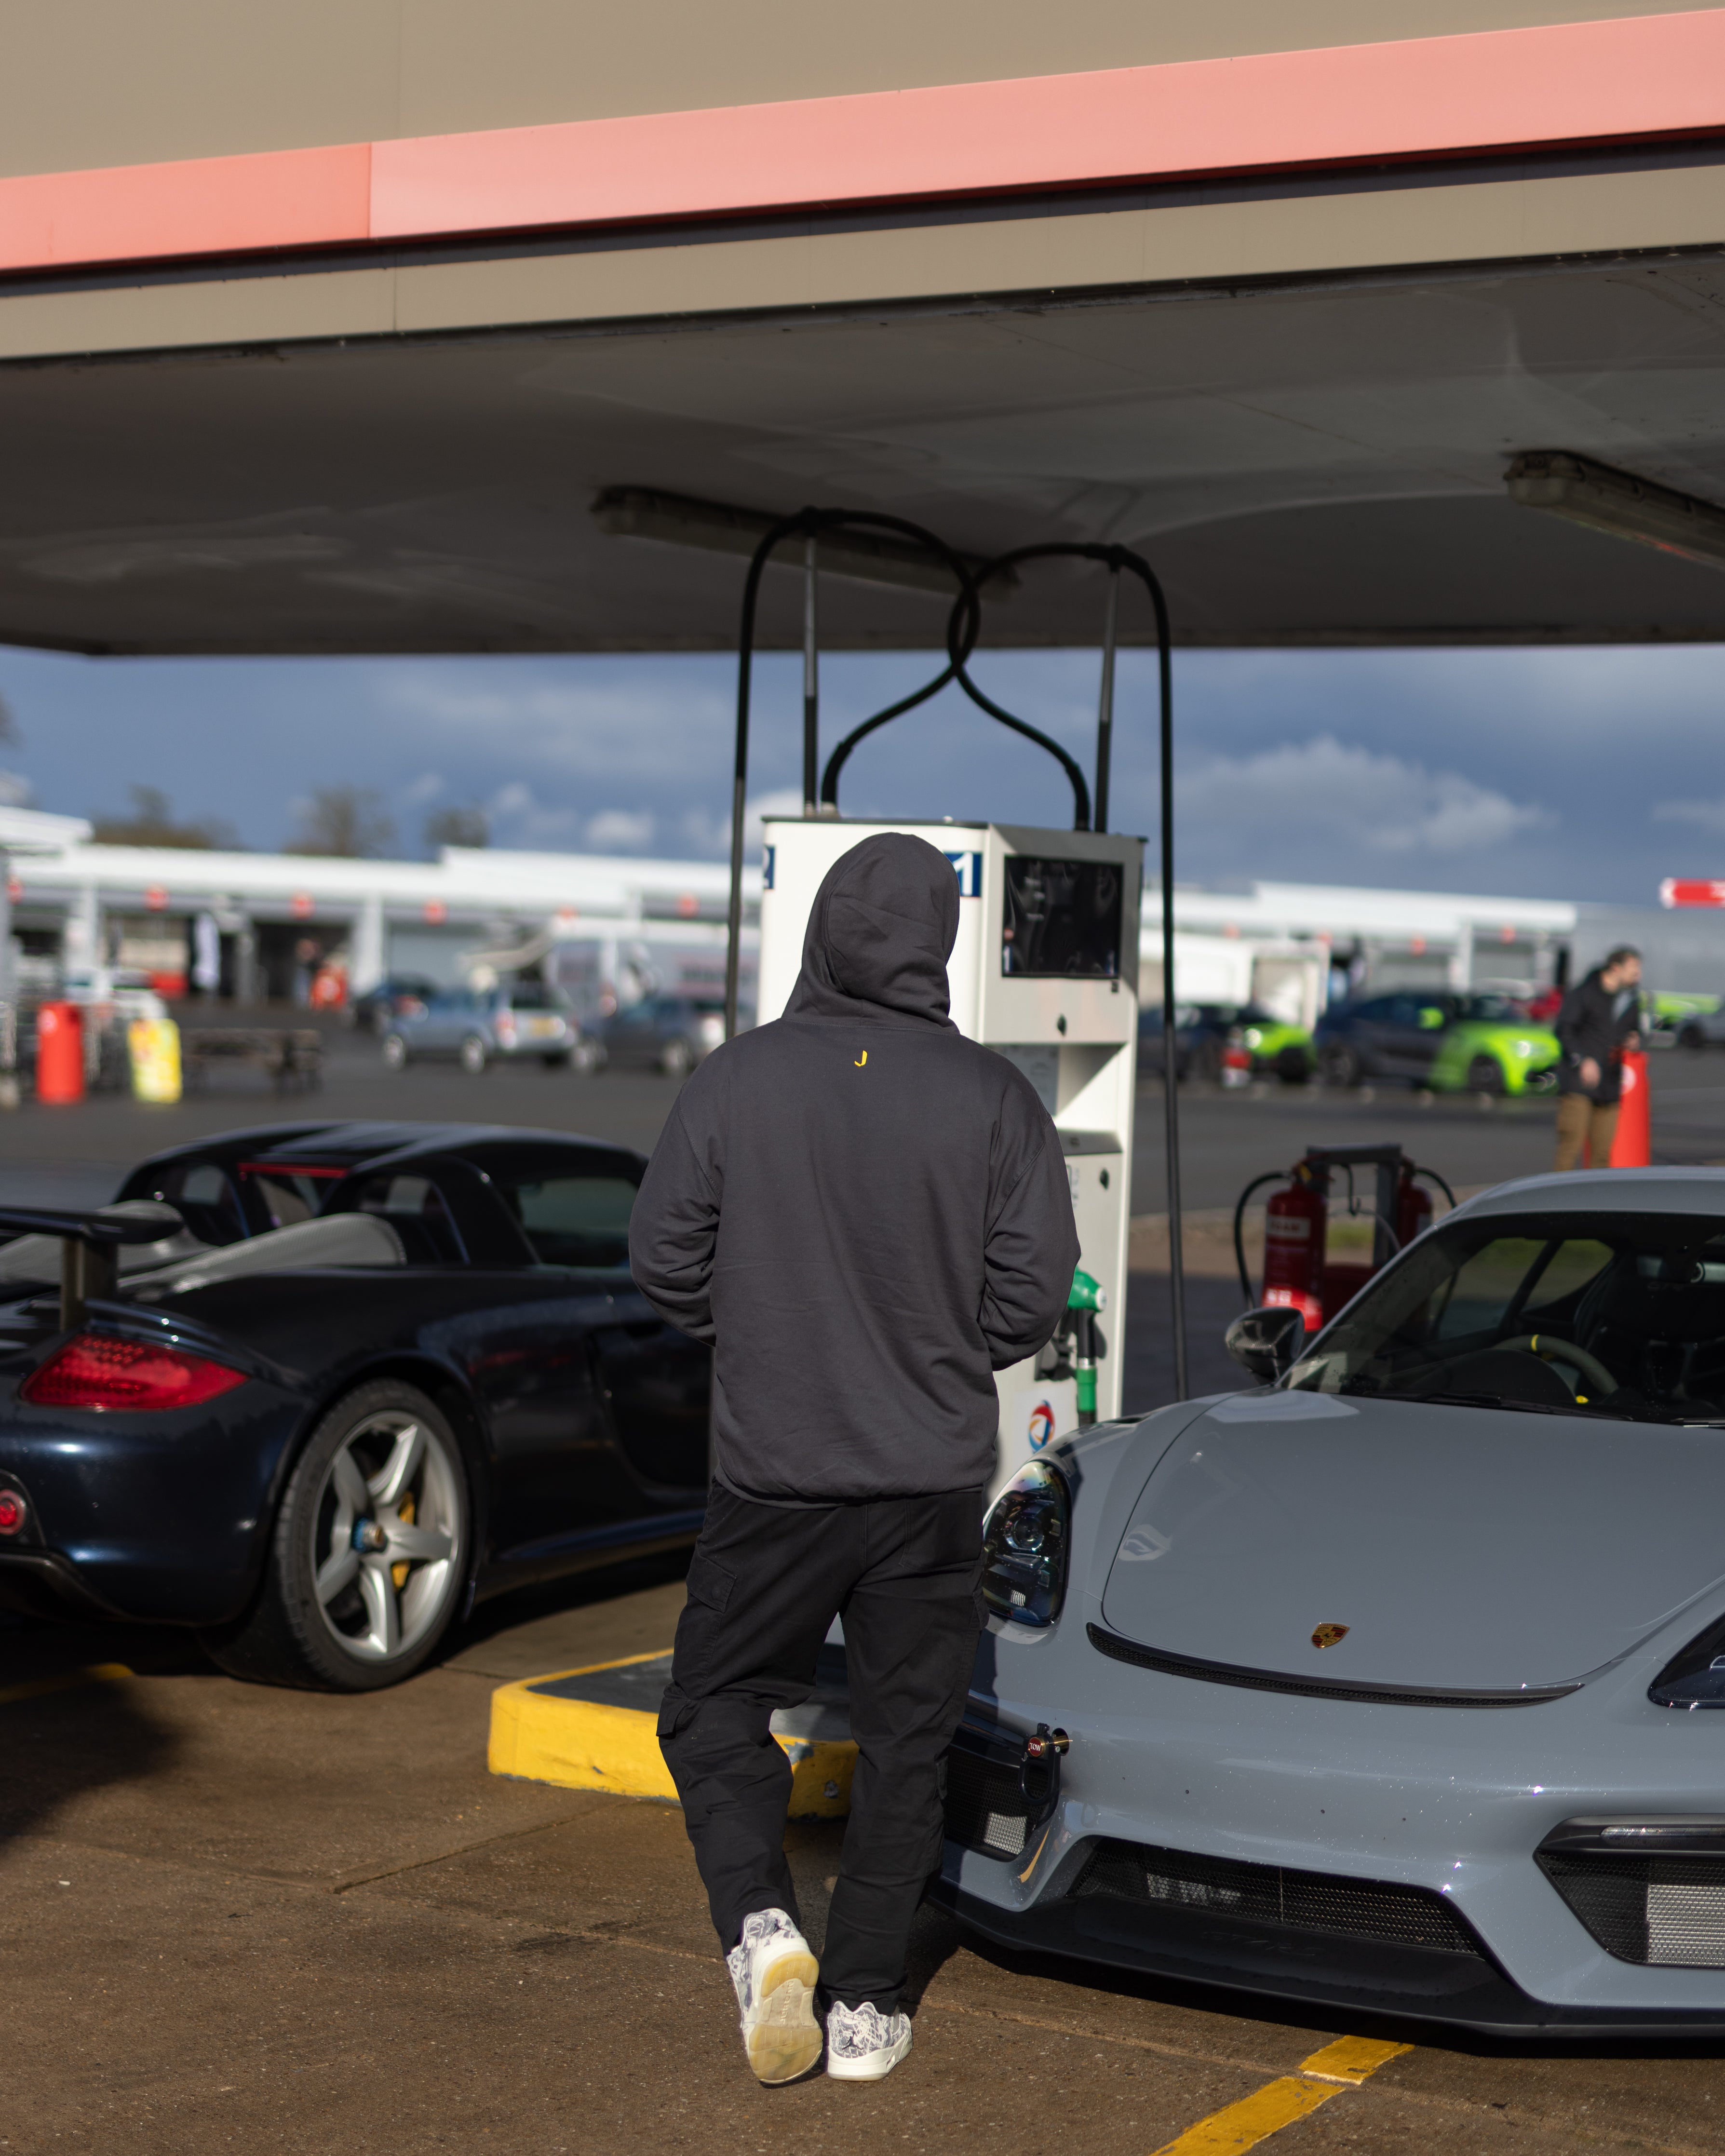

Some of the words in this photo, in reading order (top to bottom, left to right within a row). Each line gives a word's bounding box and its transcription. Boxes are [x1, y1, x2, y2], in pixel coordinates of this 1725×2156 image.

[953, 852, 972, 895] 1
[854, 1051, 867, 1066] J
[1029, 1742, 1041, 1751] TOW
